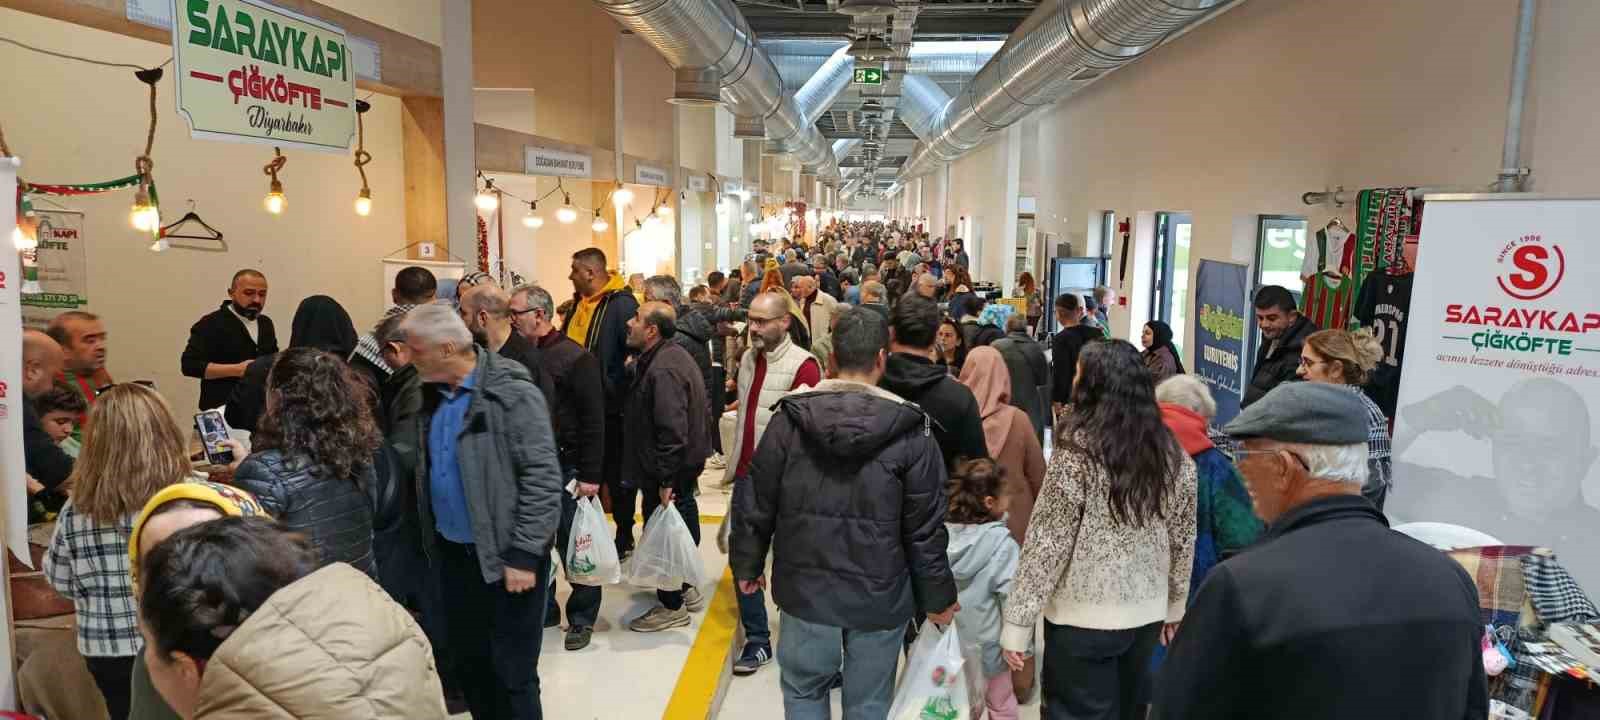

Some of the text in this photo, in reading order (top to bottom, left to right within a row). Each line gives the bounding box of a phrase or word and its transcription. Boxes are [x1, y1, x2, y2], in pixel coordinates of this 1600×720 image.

[187, 0, 347, 81] SARAYKAPI
[228, 64, 321, 110] ÇİĞKÖFTE
[247, 105, 313, 136] Diyarbakır
[1509, 245, 1548, 290] S
[1471, 329, 1573, 355] ÇİĞKÖFTE
[1470, 354, 1505, 368] lezzete
[1566, 366, 1600, 377] adres
